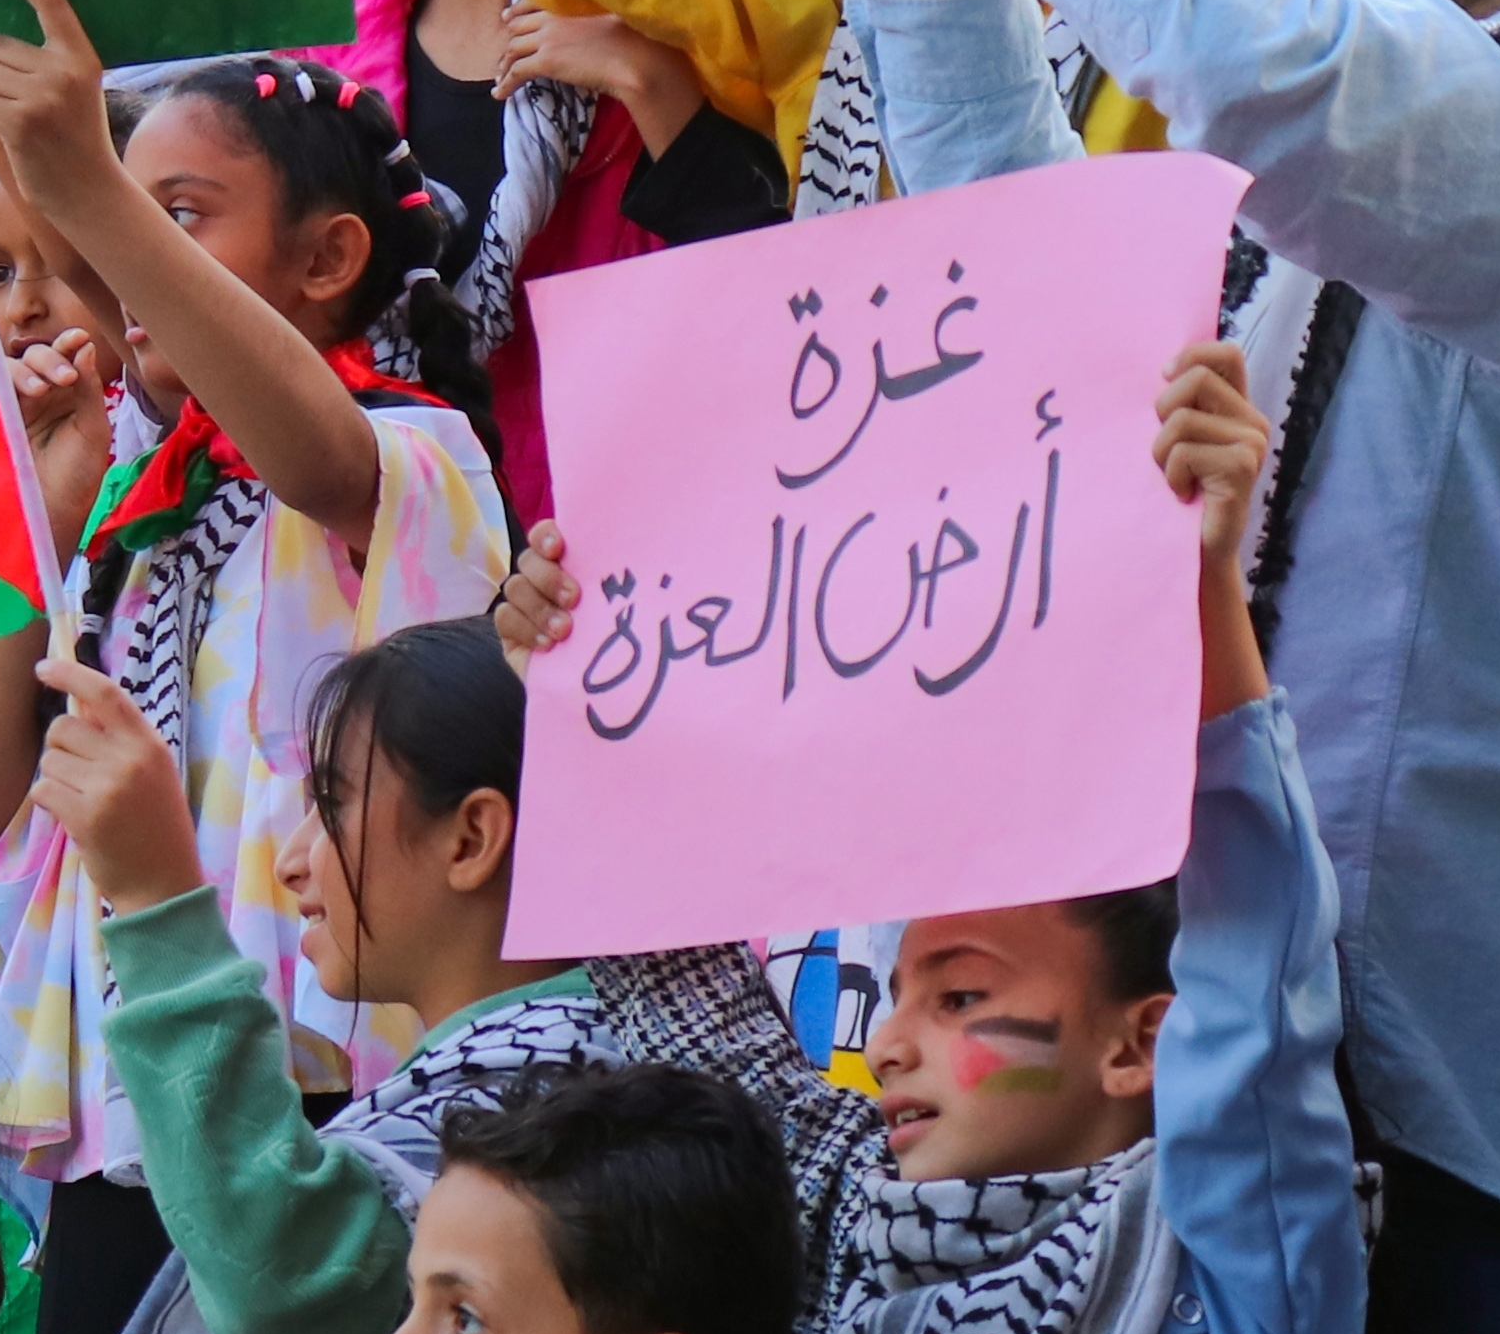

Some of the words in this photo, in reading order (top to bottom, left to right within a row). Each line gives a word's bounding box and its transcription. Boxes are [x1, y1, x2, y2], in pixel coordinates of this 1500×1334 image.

[775, 259, 985, 490] غزة
[582, 514, 806, 741] العزة
[815, 388, 1063, 697] أرض
